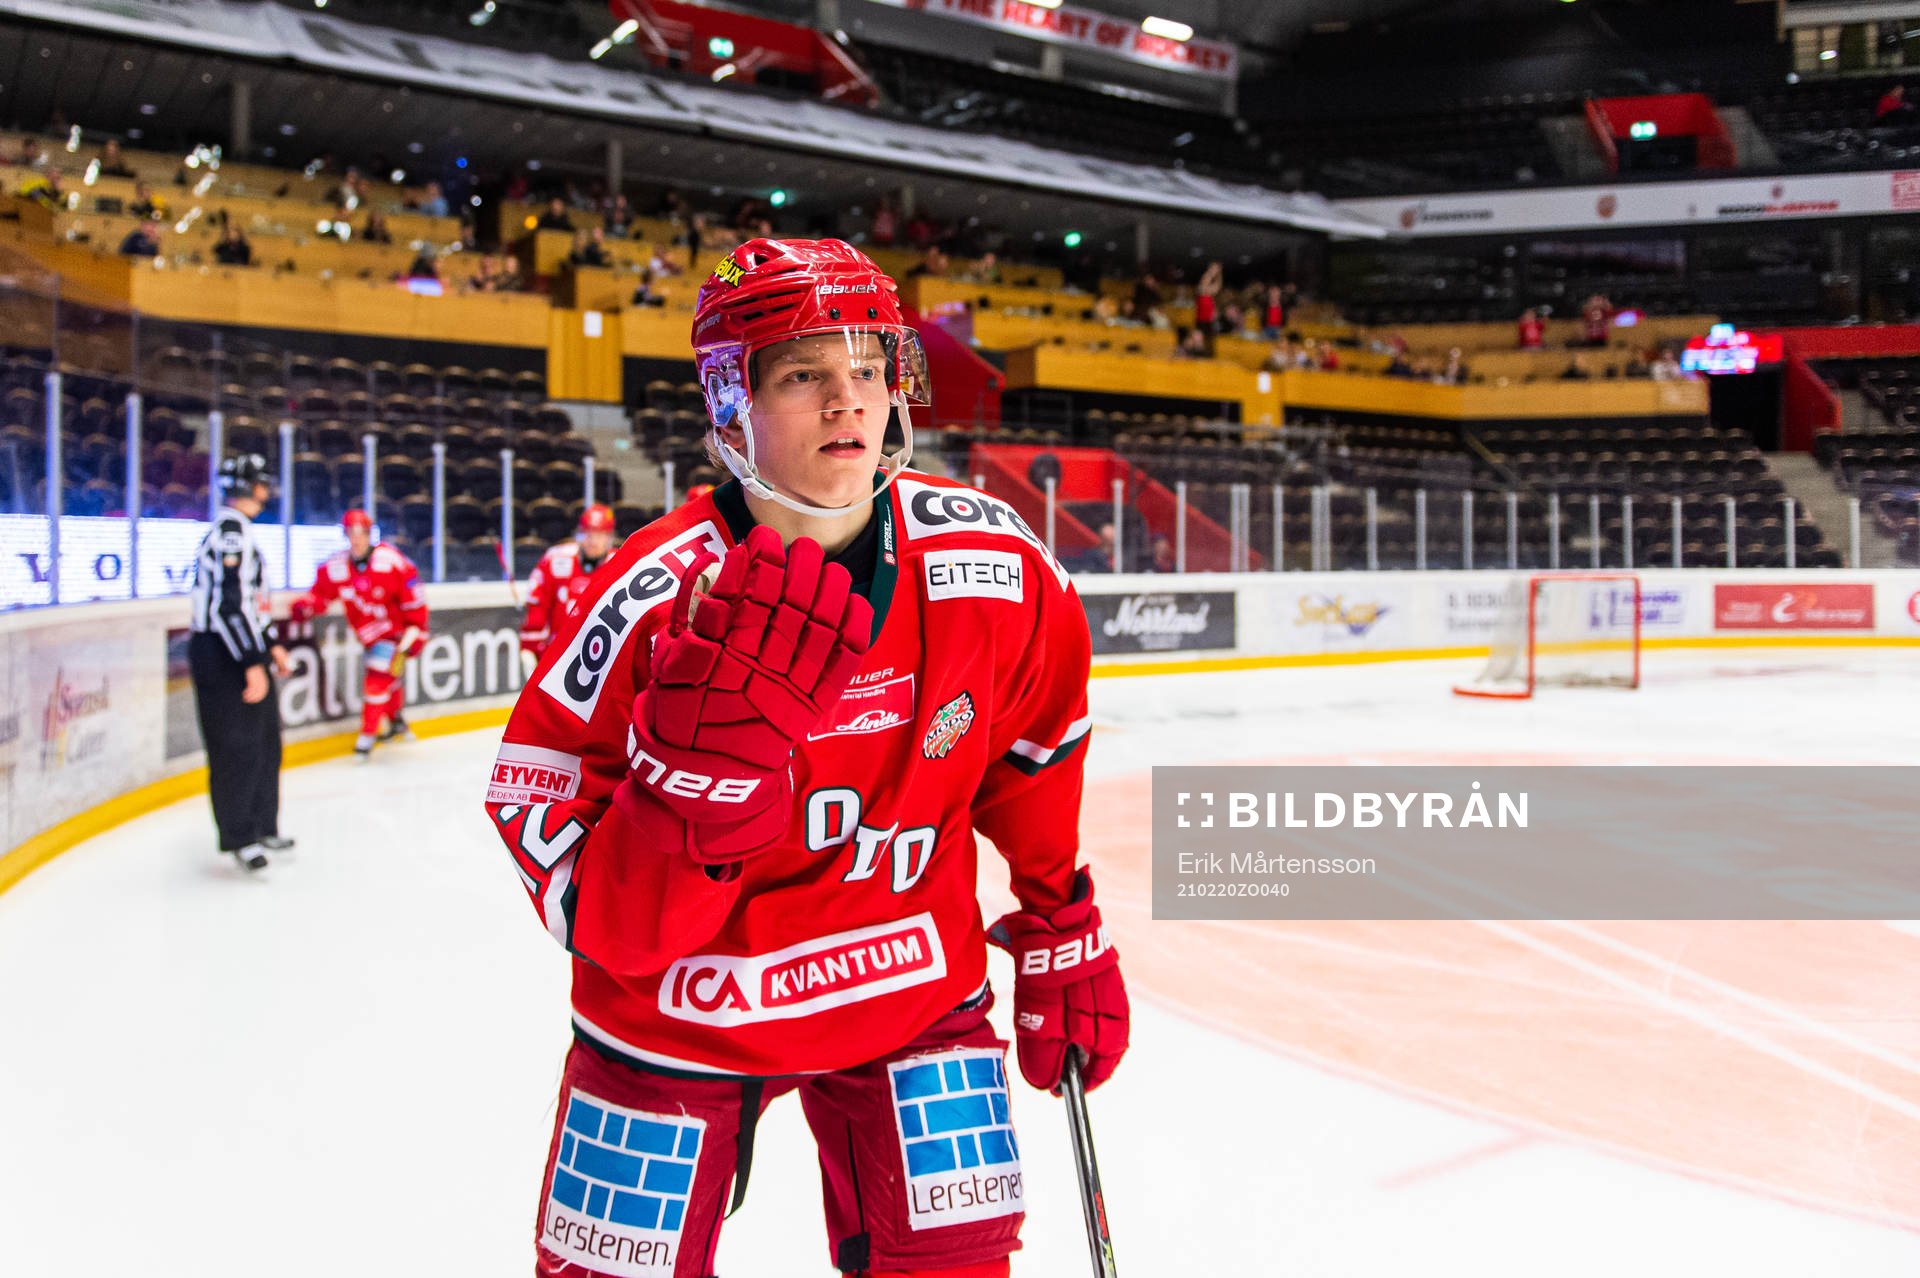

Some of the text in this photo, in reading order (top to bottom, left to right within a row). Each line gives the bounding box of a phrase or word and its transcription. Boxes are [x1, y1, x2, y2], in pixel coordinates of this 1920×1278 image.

[835, 709, 899, 731] Linde
[926, 712, 972, 742] MODO
[672, 935, 923, 1013] ICA KVANTUM
